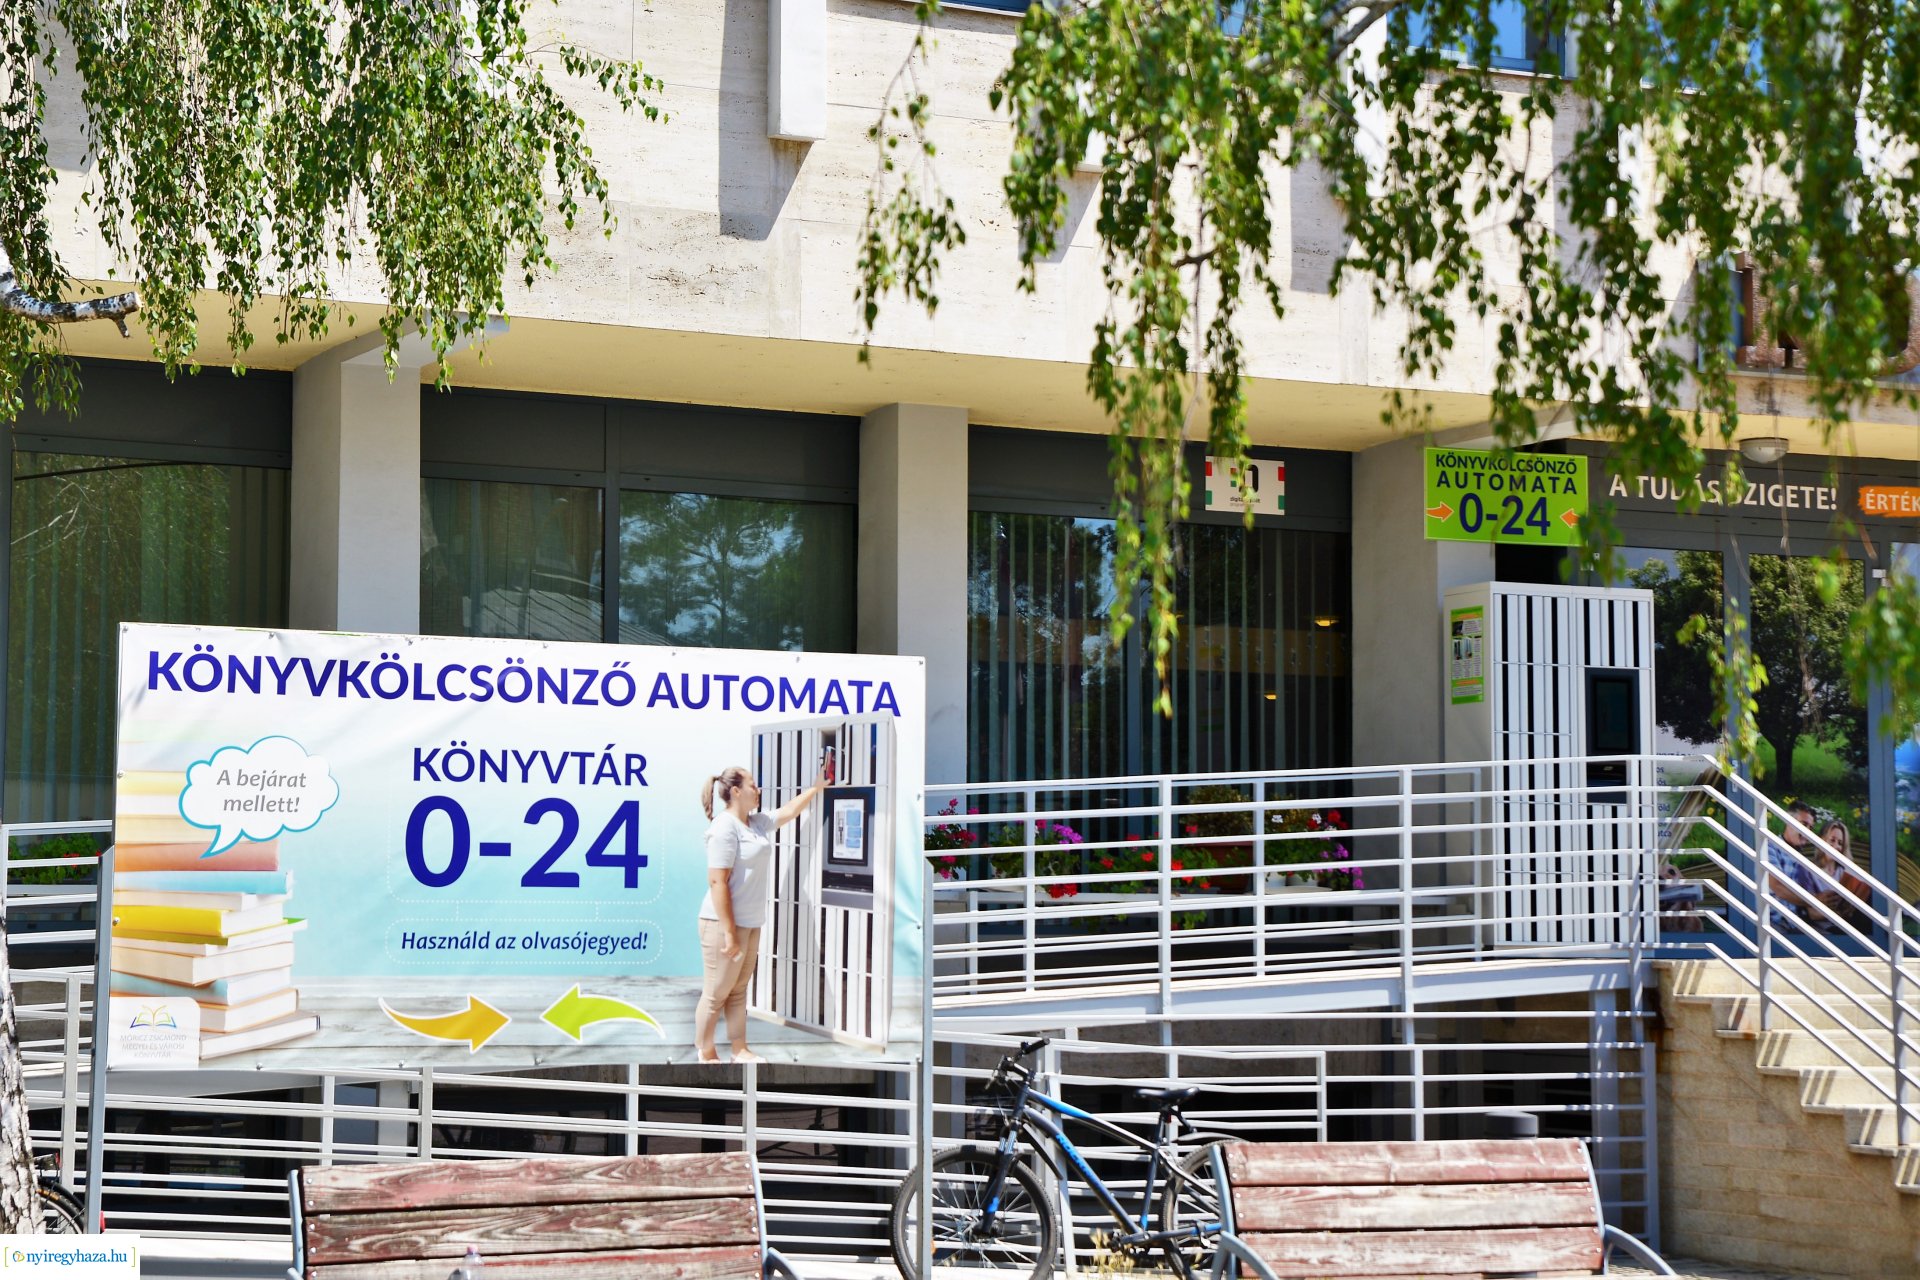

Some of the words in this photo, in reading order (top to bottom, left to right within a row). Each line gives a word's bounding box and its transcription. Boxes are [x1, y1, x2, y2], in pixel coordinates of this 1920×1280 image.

[1435, 452, 1577, 475] KÖNYVKÖLCSÖNZŐ
[1436, 470, 1577, 494] AUTOMATA
[1608, 474, 1628, 498] A
[1459, 492, 1550, 536] 0-24
[148, 643, 636, 707] KÖNYVKÖLCSÖNZŐ
[646, 671, 901, 717] AUTOMATA
[413, 740, 648, 787] KÖNYVTÁR
[216, 770, 231, 786] A
[237, 770, 307, 791] bejárat
[223, 796, 300, 813] mellett!
[405, 795, 648, 889] 0-24
[401, 931, 490, 950] Használd
[495, 936, 516, 949] az
[521, 931, 648, 955] olvasójegyed!
